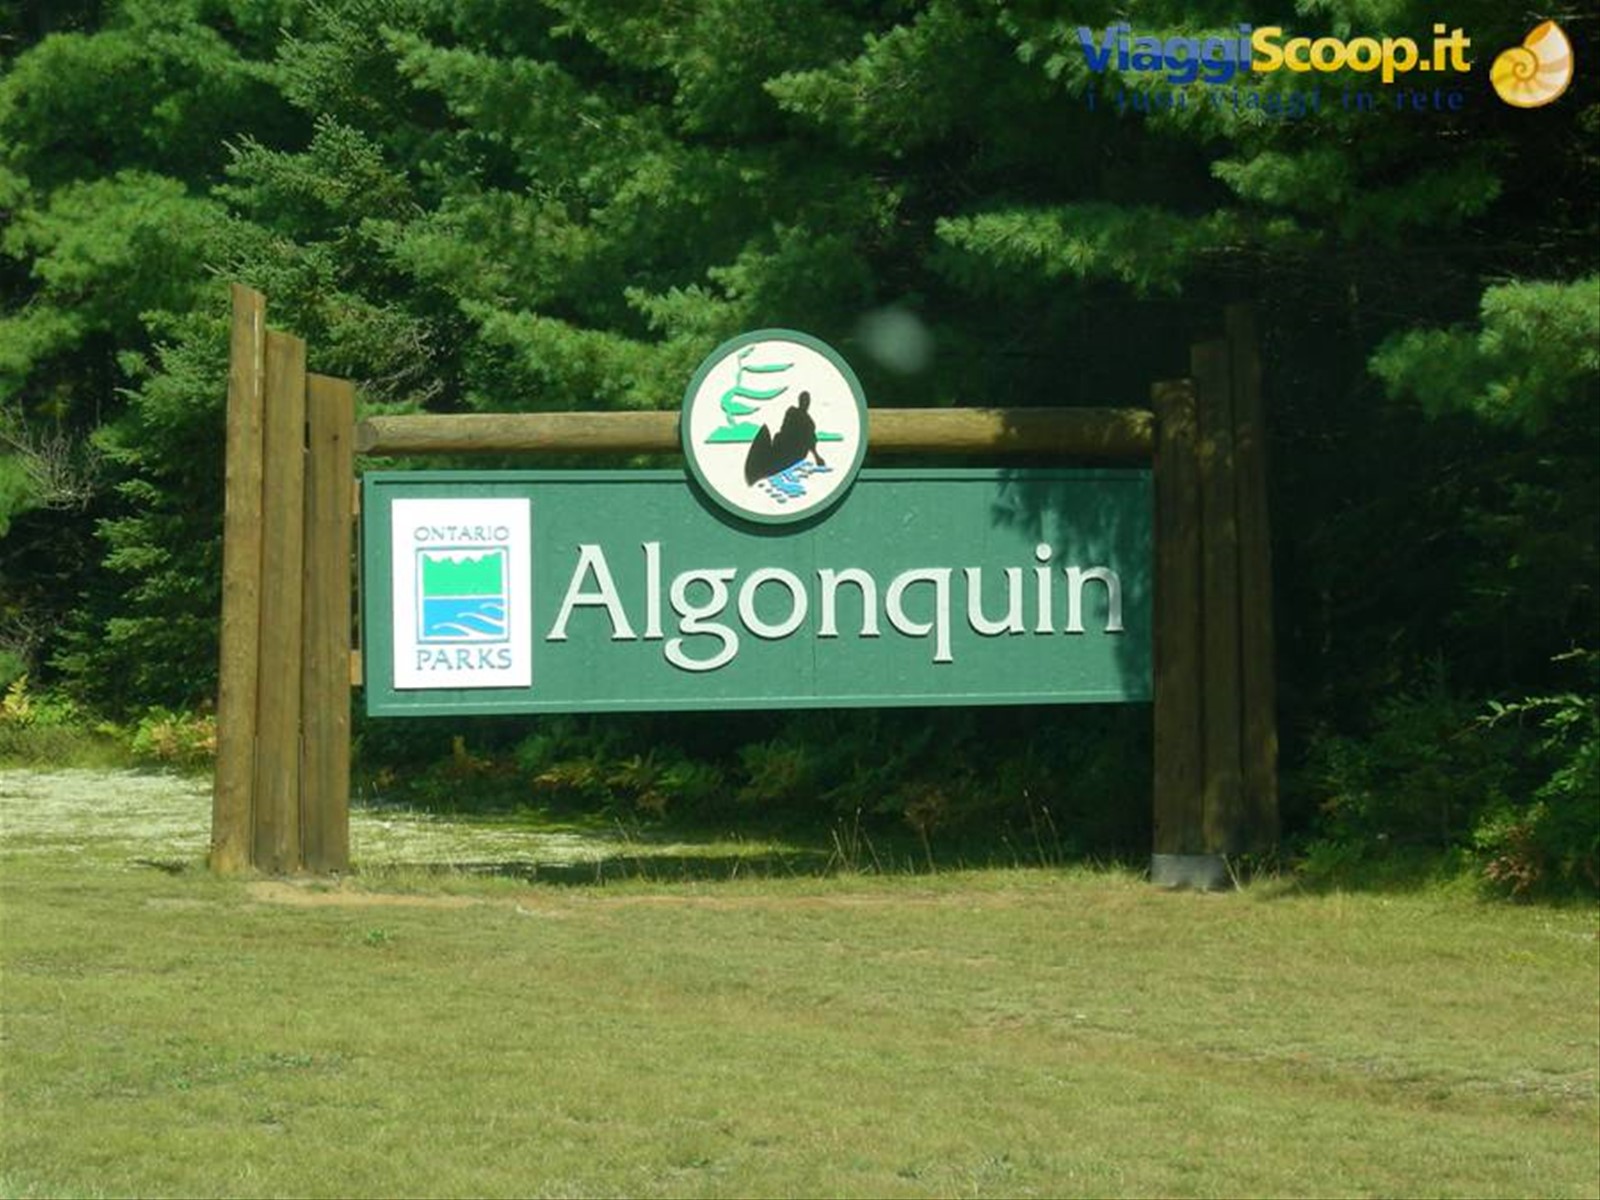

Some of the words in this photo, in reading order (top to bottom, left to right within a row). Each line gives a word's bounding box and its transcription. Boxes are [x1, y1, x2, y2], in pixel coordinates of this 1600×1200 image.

[413, 525, 510, 541] ONTARIO
[545, 541, 1125, 672] Algonquin
[415, 648, 512, 671] PARKS
